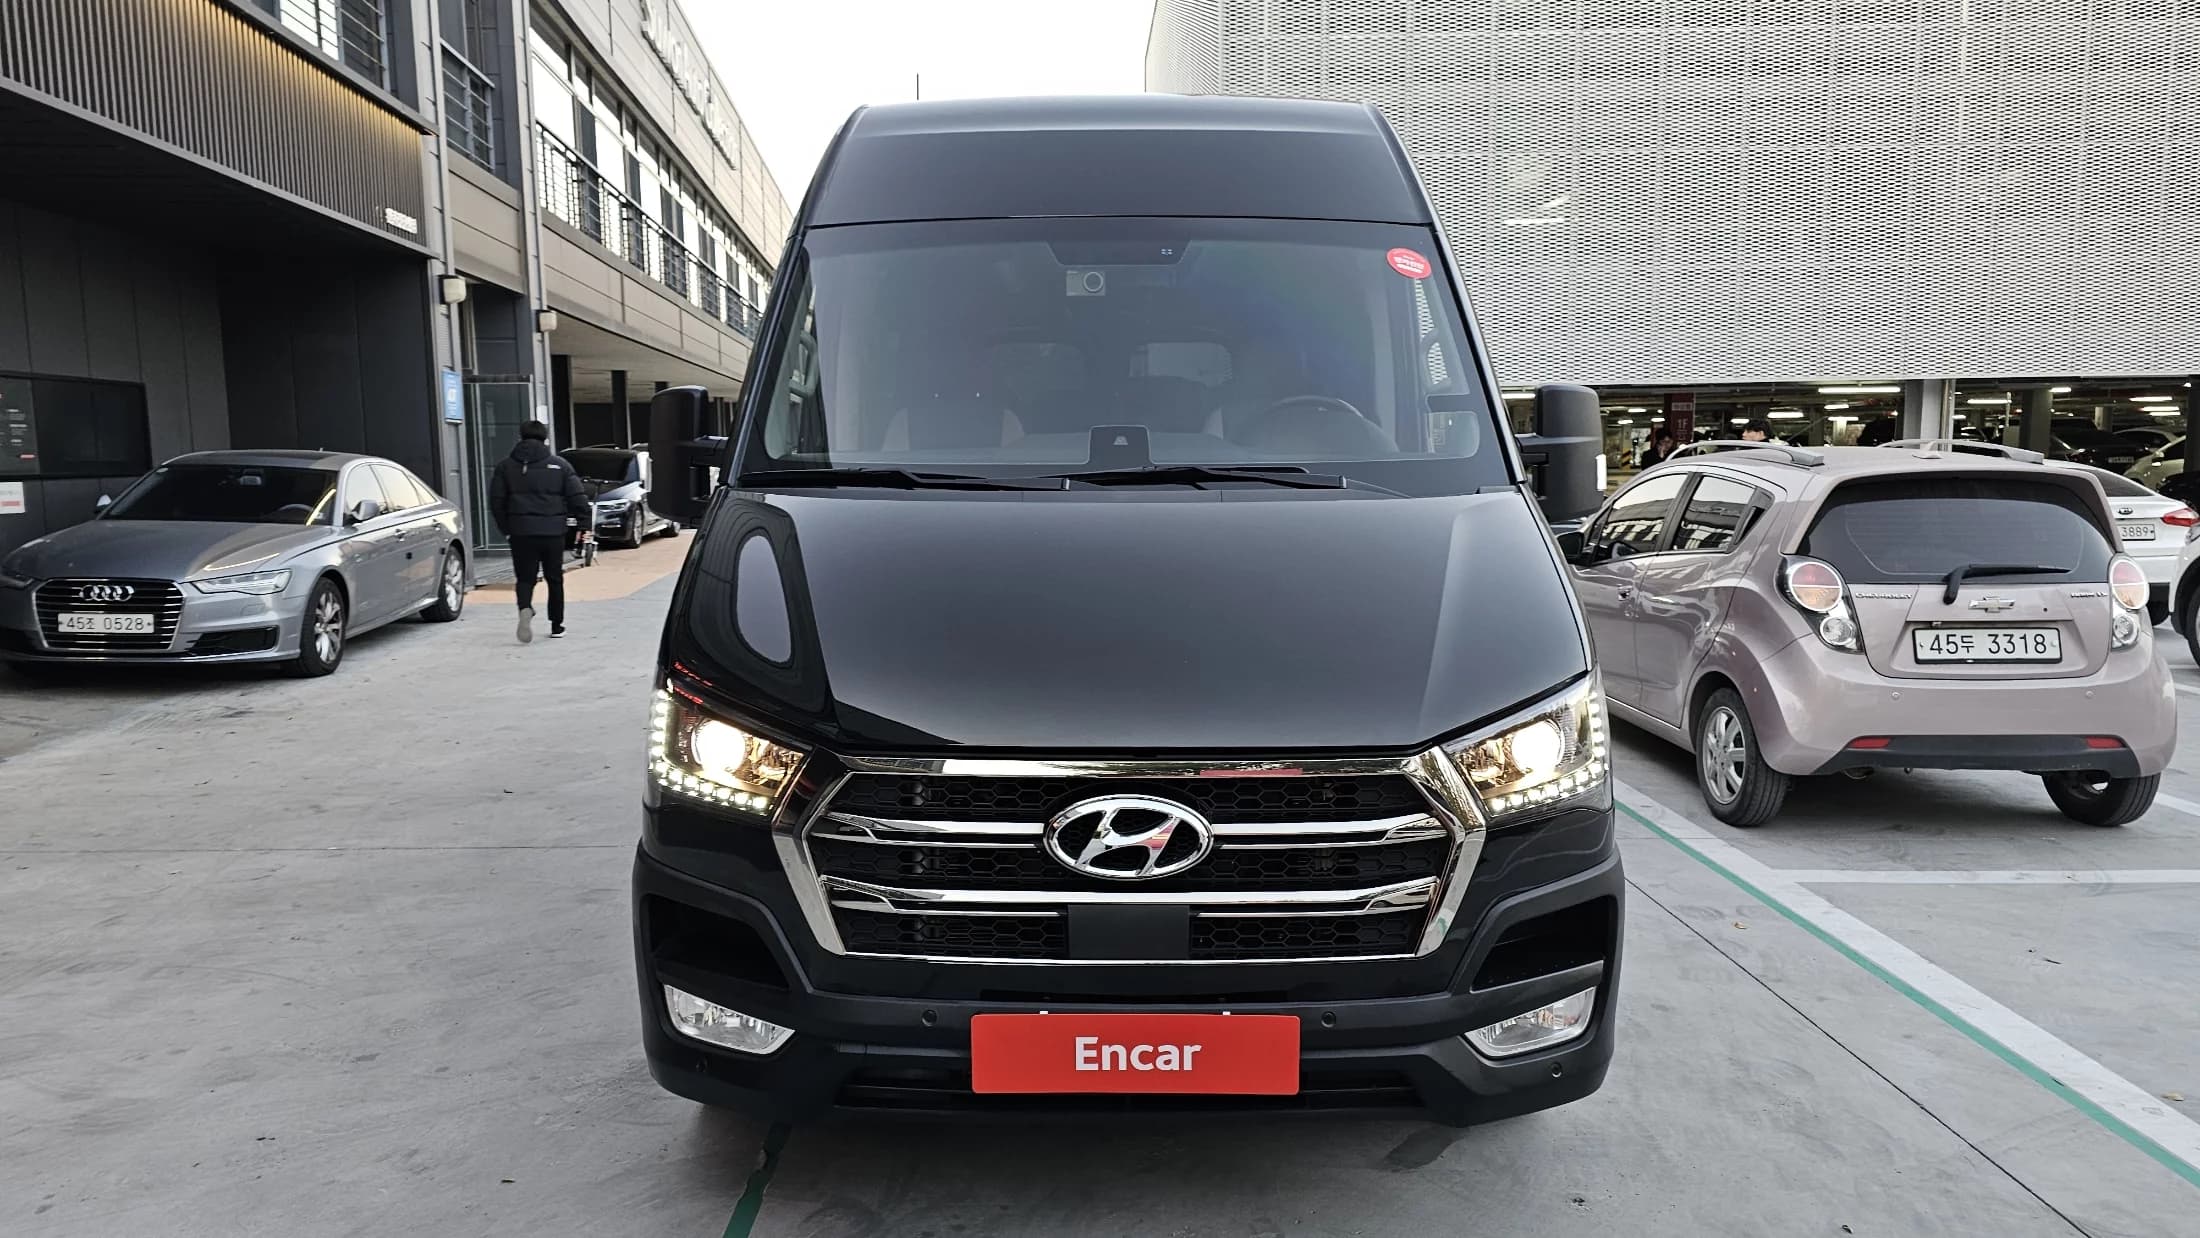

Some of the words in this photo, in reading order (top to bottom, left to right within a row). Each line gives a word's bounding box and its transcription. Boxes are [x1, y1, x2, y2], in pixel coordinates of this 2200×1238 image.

[2121, 526, 2149, 538] 3889
[66, 616, 96, 630] 45조
[103, 617, 145, 631] 0528
[1929, 633, 1975, 655] 45두
[1987, 633, 2048, 655] 3318
[1075, 1036, 1202, 1072] Encar
